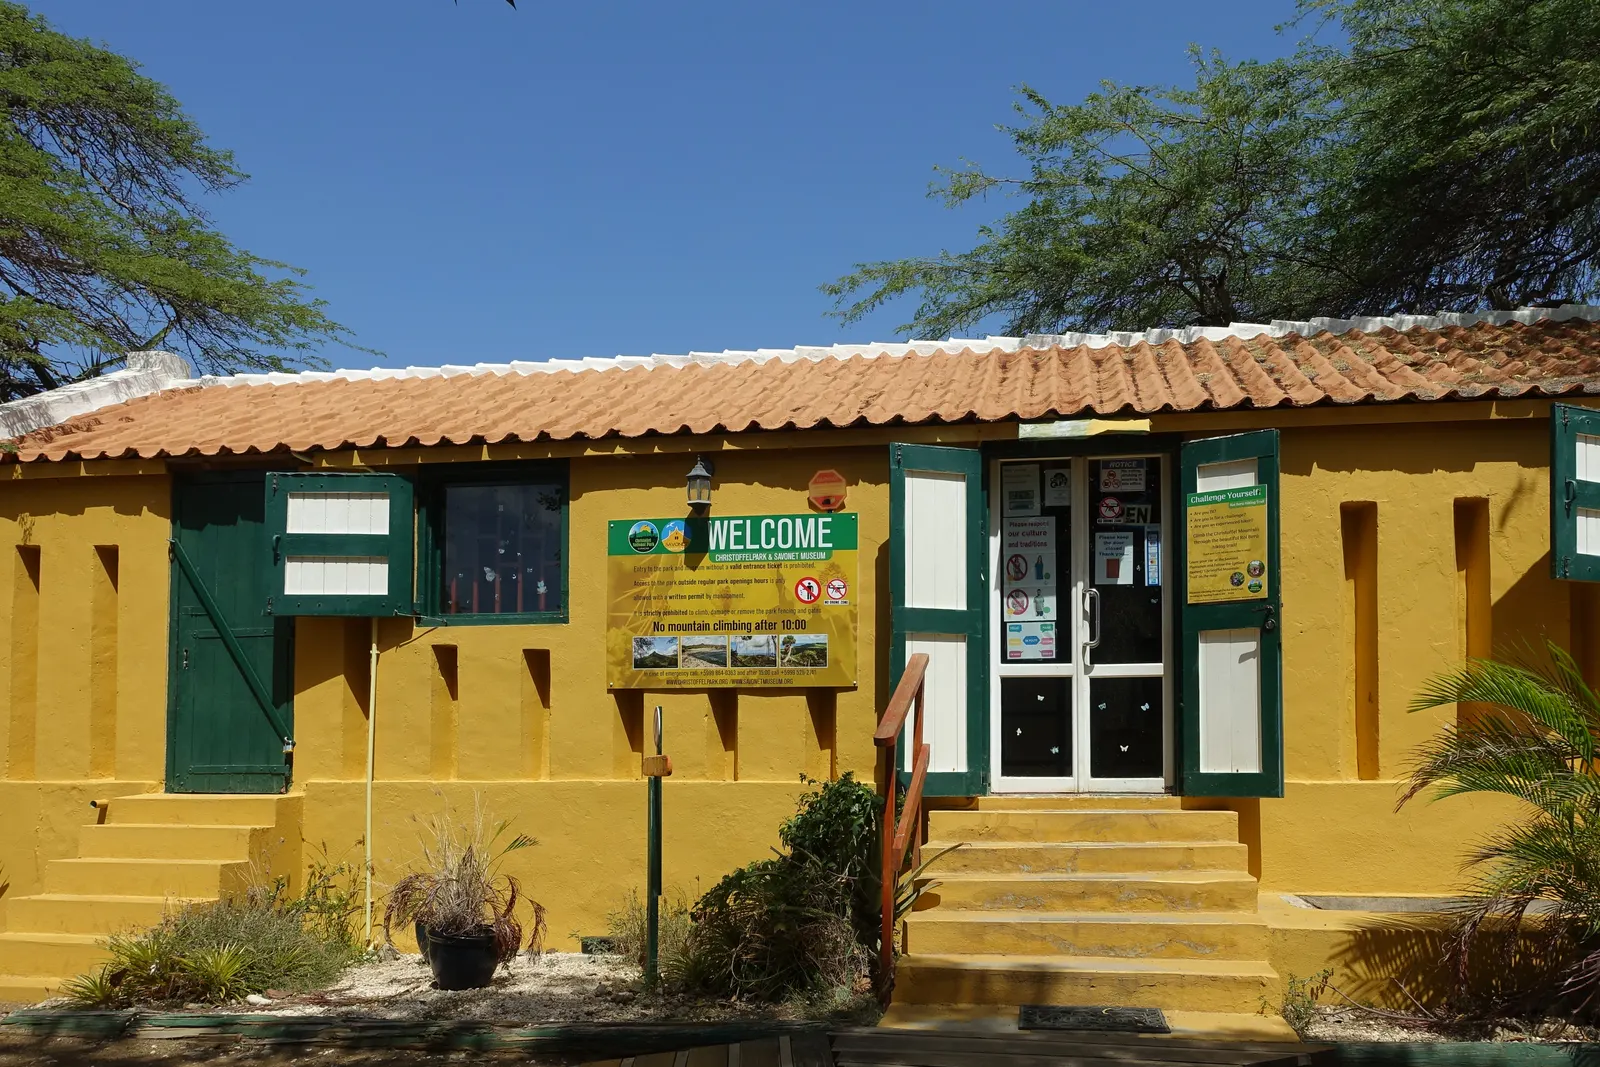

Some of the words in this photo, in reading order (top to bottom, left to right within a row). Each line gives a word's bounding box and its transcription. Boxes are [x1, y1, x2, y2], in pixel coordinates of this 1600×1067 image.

[1190, 494, 1226, 503] Challenge
[708, 517, 833, 550] WELCOME
[716, 553, 767, 561] CHRISTOFFELPARK
[653, 621, 665, 632] No
[668, 620, 710, 631] mountain
[713, 620, 752, 633] climbing
[754, 620, 777, 630] after
[782, 619, 806, 630] 10:00
